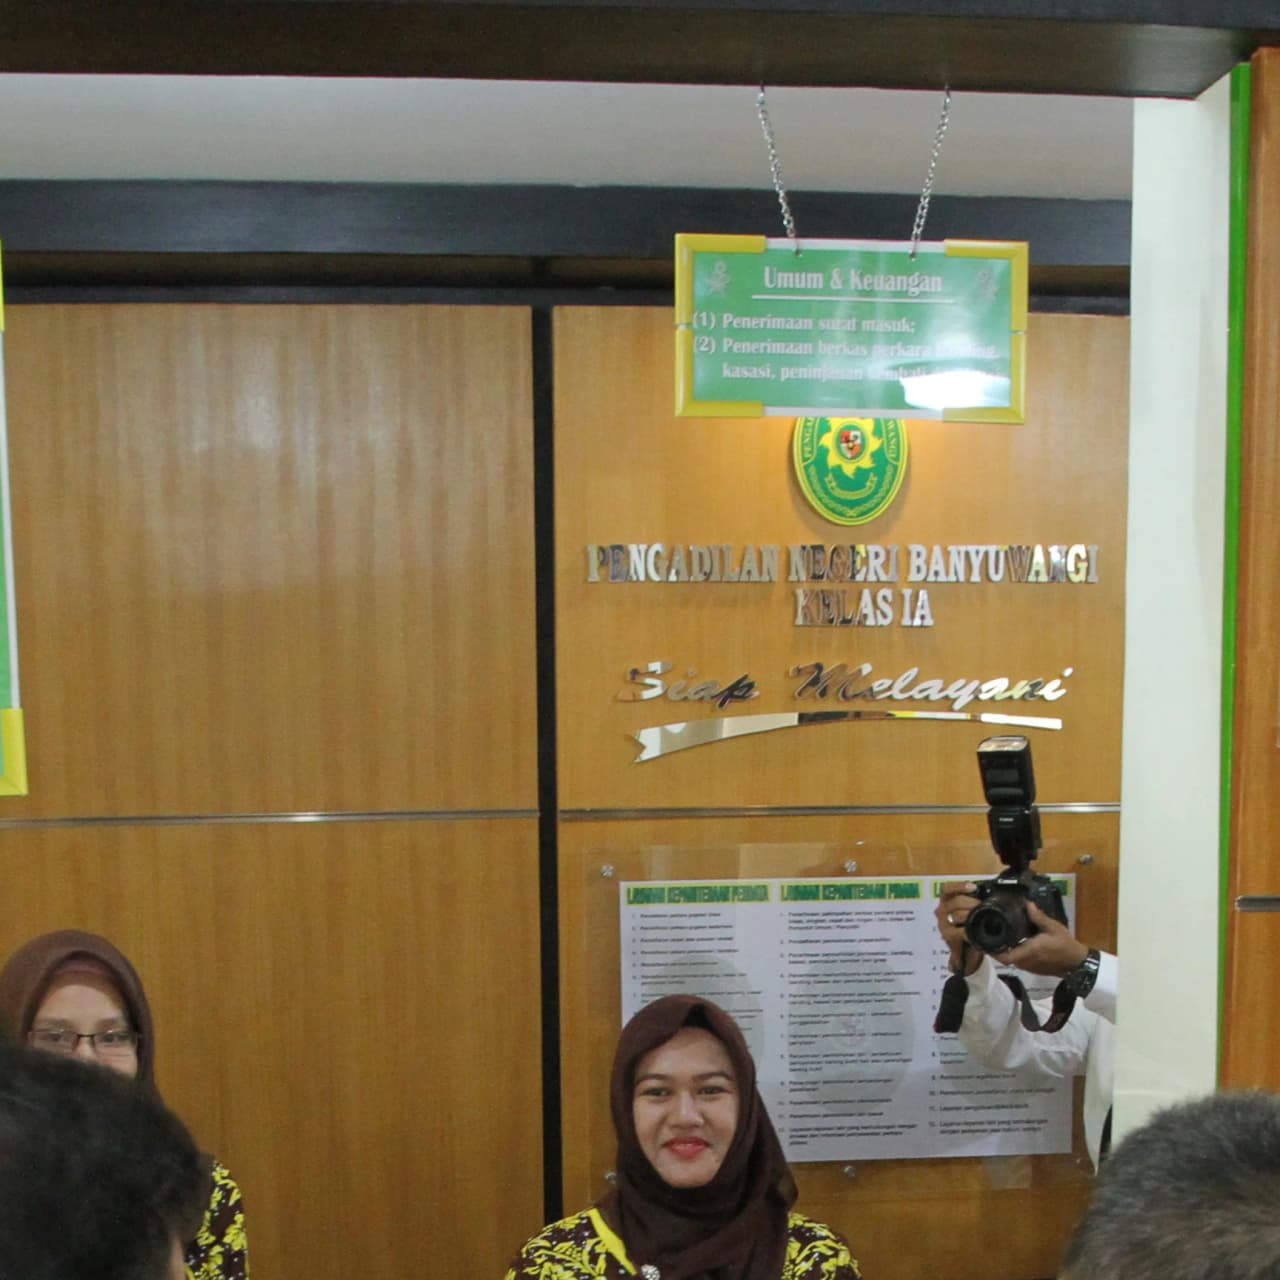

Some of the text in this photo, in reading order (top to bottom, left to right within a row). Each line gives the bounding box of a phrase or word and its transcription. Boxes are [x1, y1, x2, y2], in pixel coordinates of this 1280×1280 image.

[764, 266, 943, 296] Umum & Keuangan
[692, 313, 915, 334] (1) Penerimaan surat masuk;
[692, 336, 716, 353] (2)
[722, 337, 812, 354] Penerimaan
[722, 362, 775, 380] kasasi,
[588, 544, 1099, 584] PENGADILAN NEGERI BANYUWANGI
[794, 589, 933, 626] KELAS IA
[619, 661, 1074, 711] Siap Melayani
